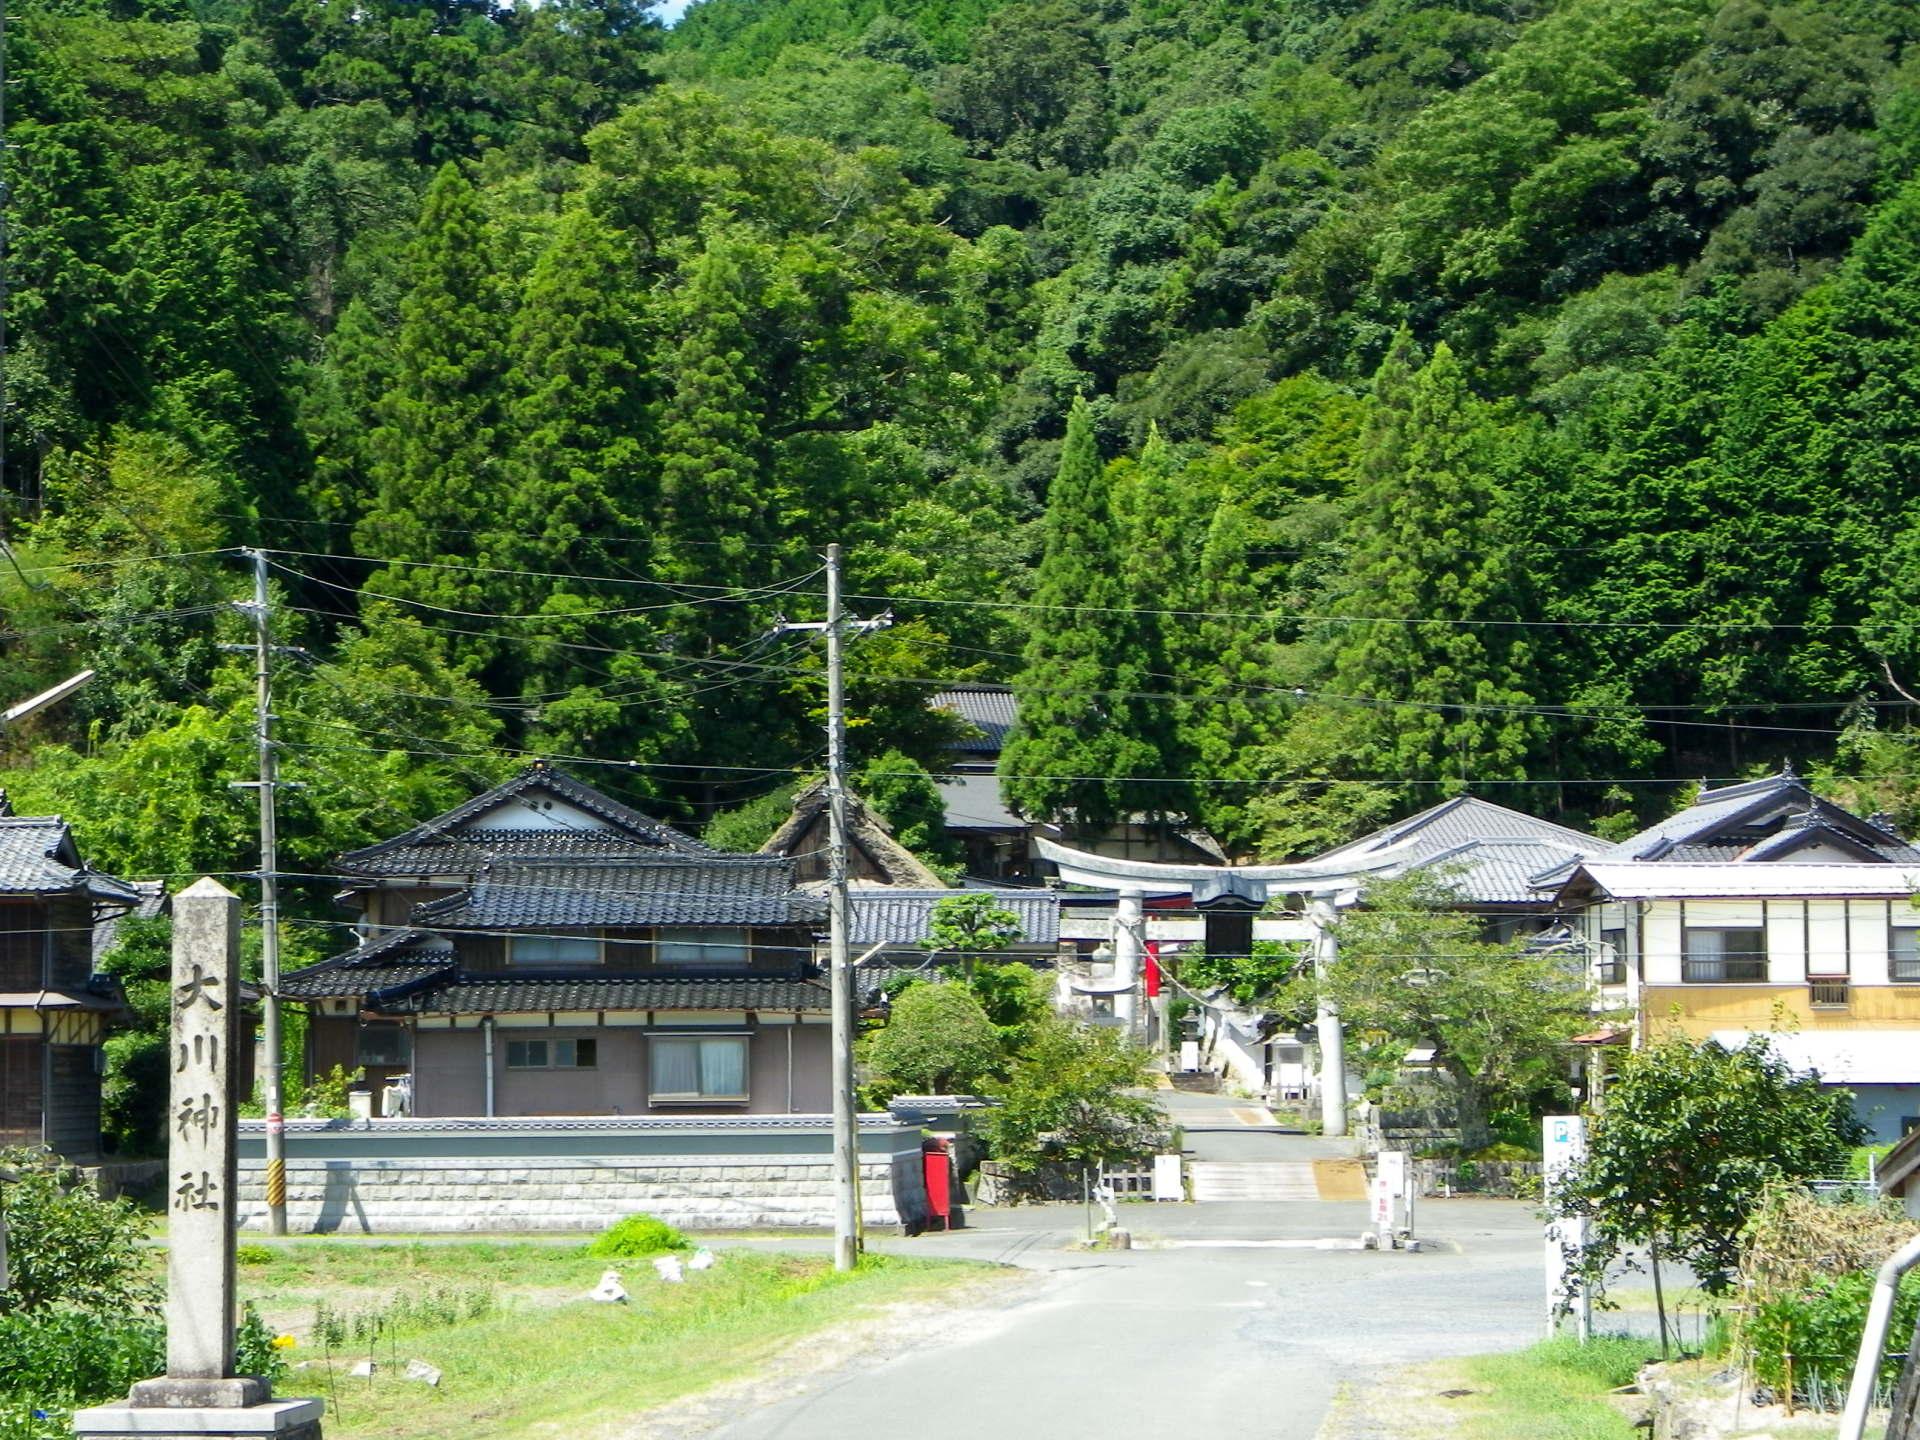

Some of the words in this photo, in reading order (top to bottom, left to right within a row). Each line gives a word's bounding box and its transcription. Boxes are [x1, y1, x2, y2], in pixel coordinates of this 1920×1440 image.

[175, 963, 223, 1212] 大川神社
[1555, 1122, 1568, 1141] P
